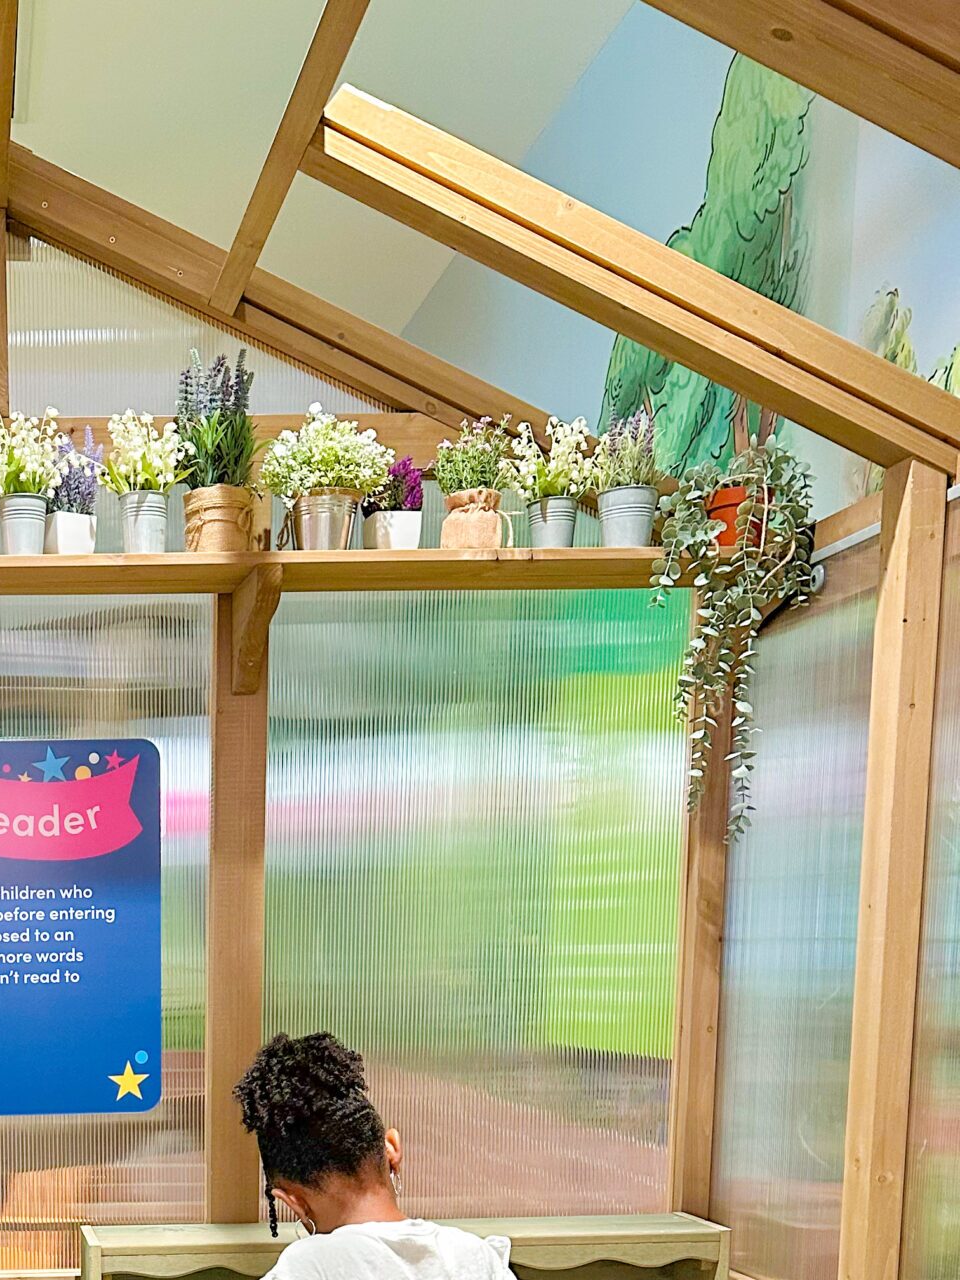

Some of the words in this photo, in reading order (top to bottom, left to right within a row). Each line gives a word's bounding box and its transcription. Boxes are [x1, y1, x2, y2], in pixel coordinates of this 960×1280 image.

[59, 884, 93, 899] who
[49, 905, 116, 924] entering
[34, 928, 50, 942] to
[54, 930, 75, 942] an
[35, 947, 84, 962] words
[23, 969, 60, 984] read
[64, 970, 81, 983] to
